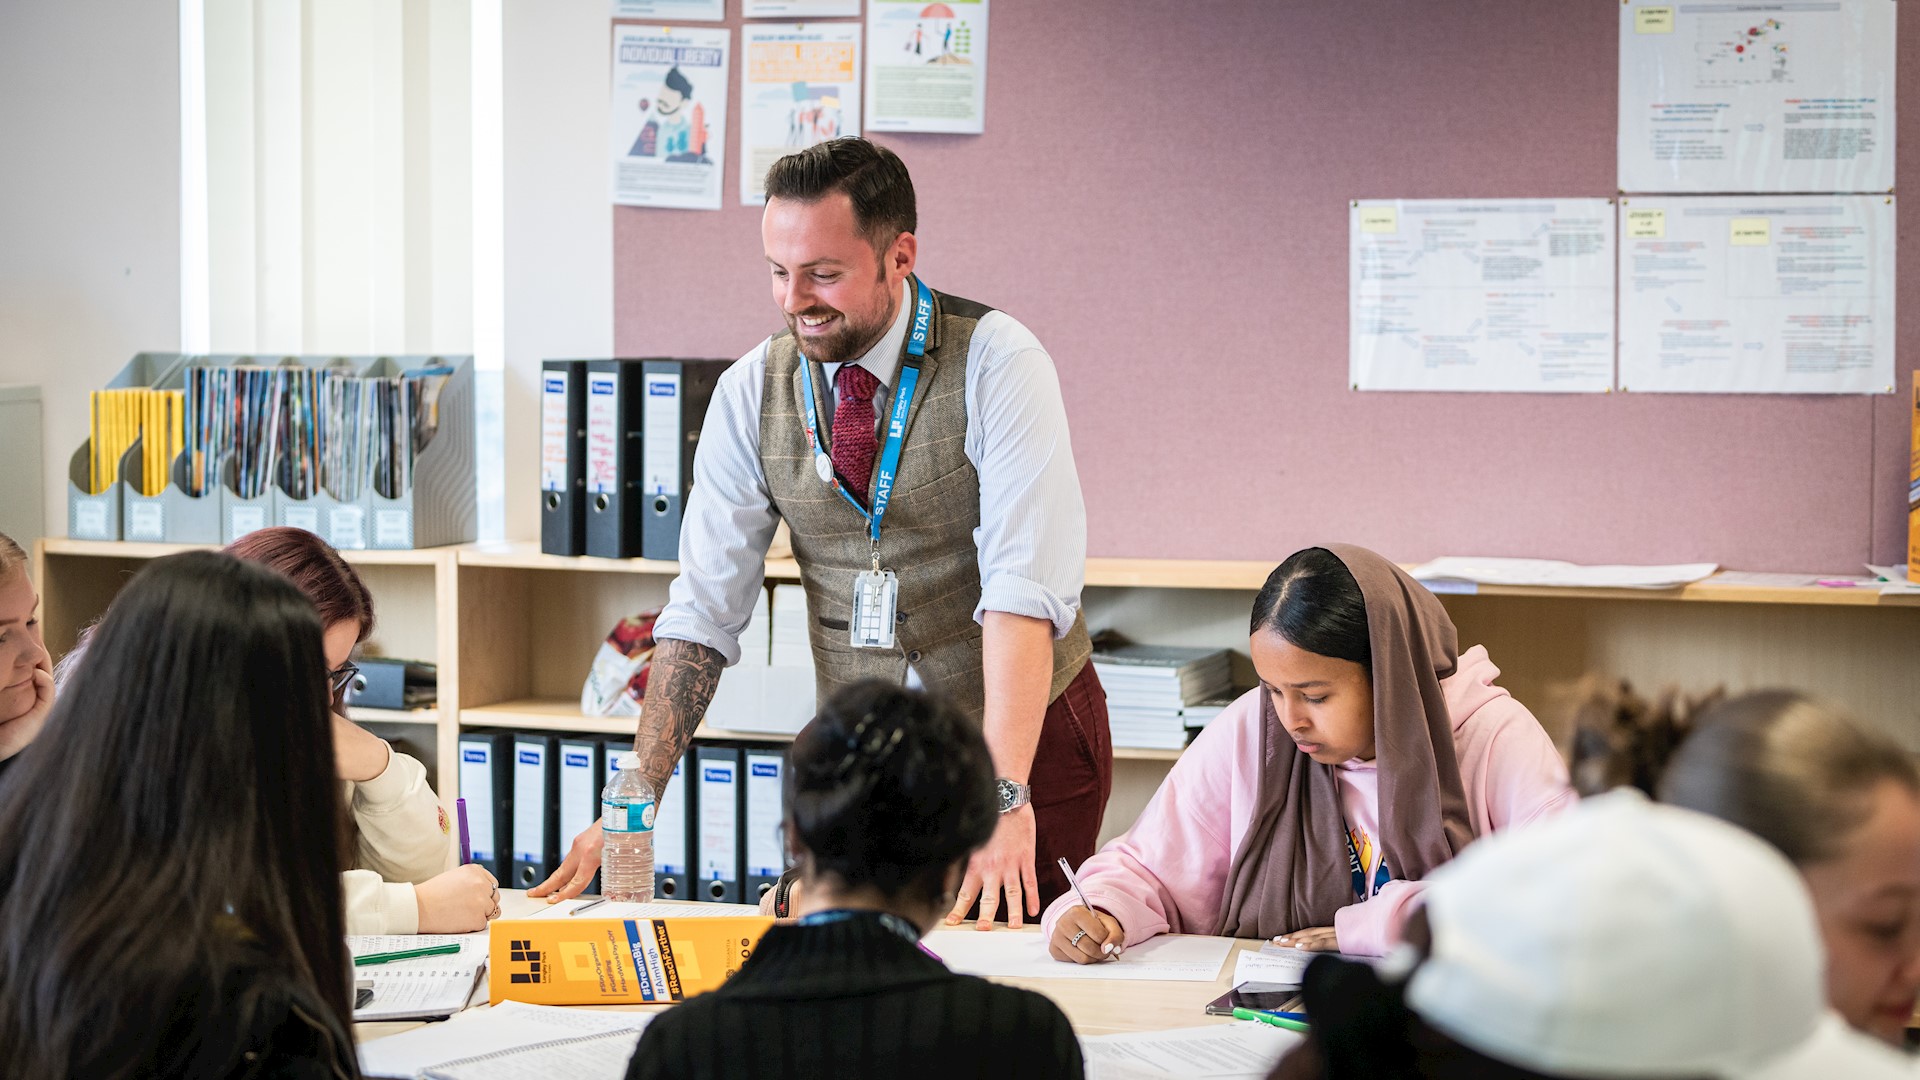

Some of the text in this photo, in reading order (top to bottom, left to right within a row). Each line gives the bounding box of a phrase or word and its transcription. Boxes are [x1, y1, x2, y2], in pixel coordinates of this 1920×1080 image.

[621, 46, 721, 66] INDIVIDUAL LIBERTY
[913, 298, 930, 342] STAFF
[875, 470, 893, 516] STAFF
[589, 942, 606, 992] #StayOrganised
[607, 929, 628, 992] #HardWorkPaysOff
[632, 941, 651, 996] #DreamBig
[647, 947, 665, 994] #AimHigh
[657, 925, 680, 994] #ReachFurther
